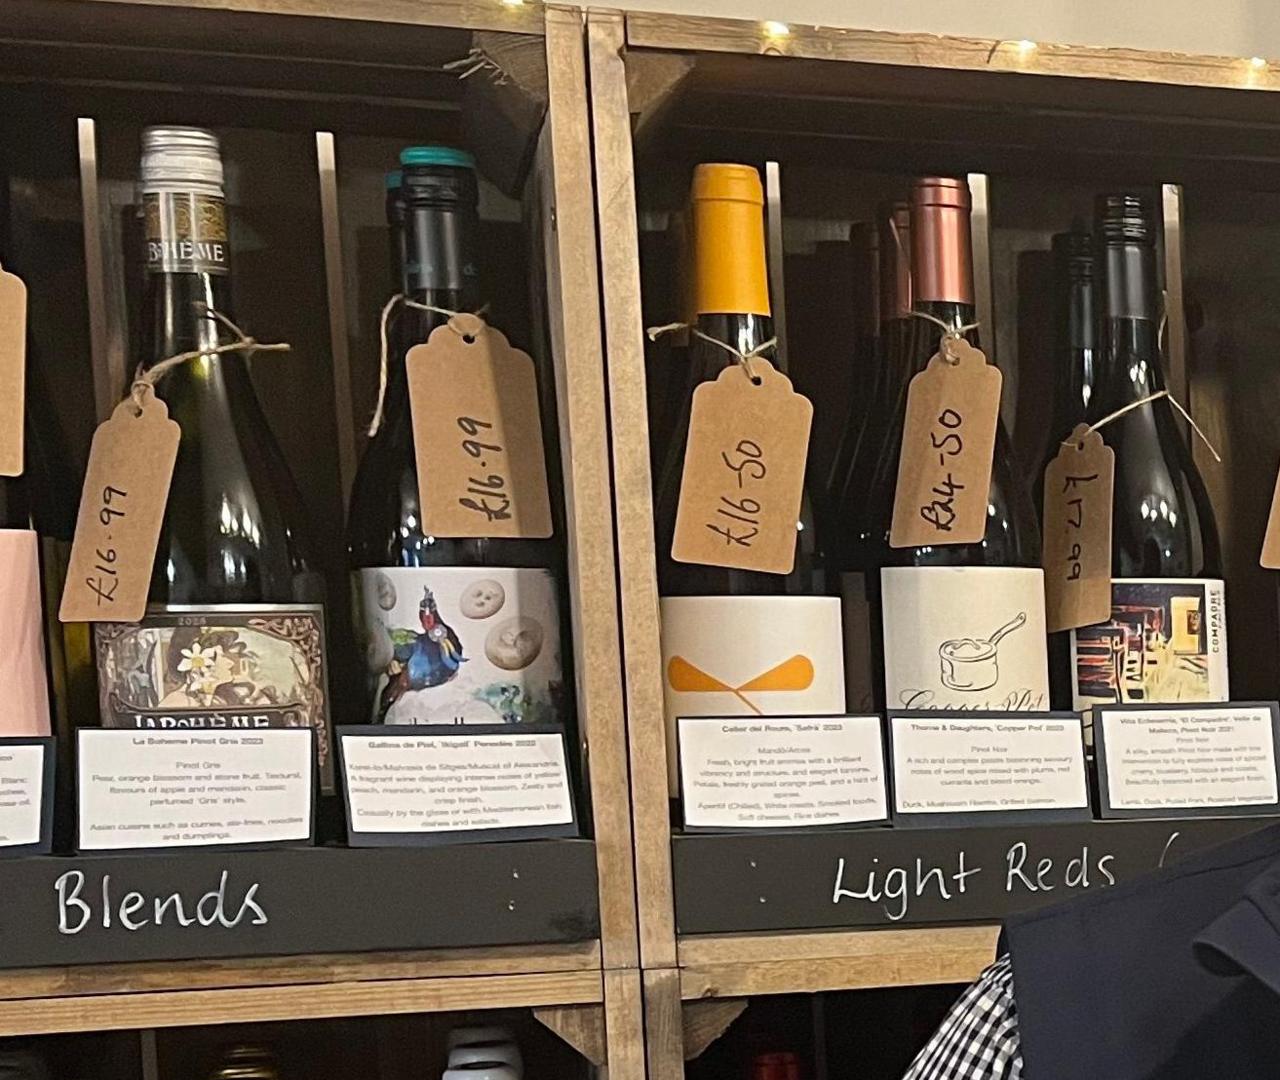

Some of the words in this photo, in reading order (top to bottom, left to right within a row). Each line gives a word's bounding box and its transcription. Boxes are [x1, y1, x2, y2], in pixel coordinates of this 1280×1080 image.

[86, 486, 128, 603] £16.99
[55, 868, 268, 935] Blends
[832, 849, 982, 921] Light
[1006, 841, 1115, 892] Reds
